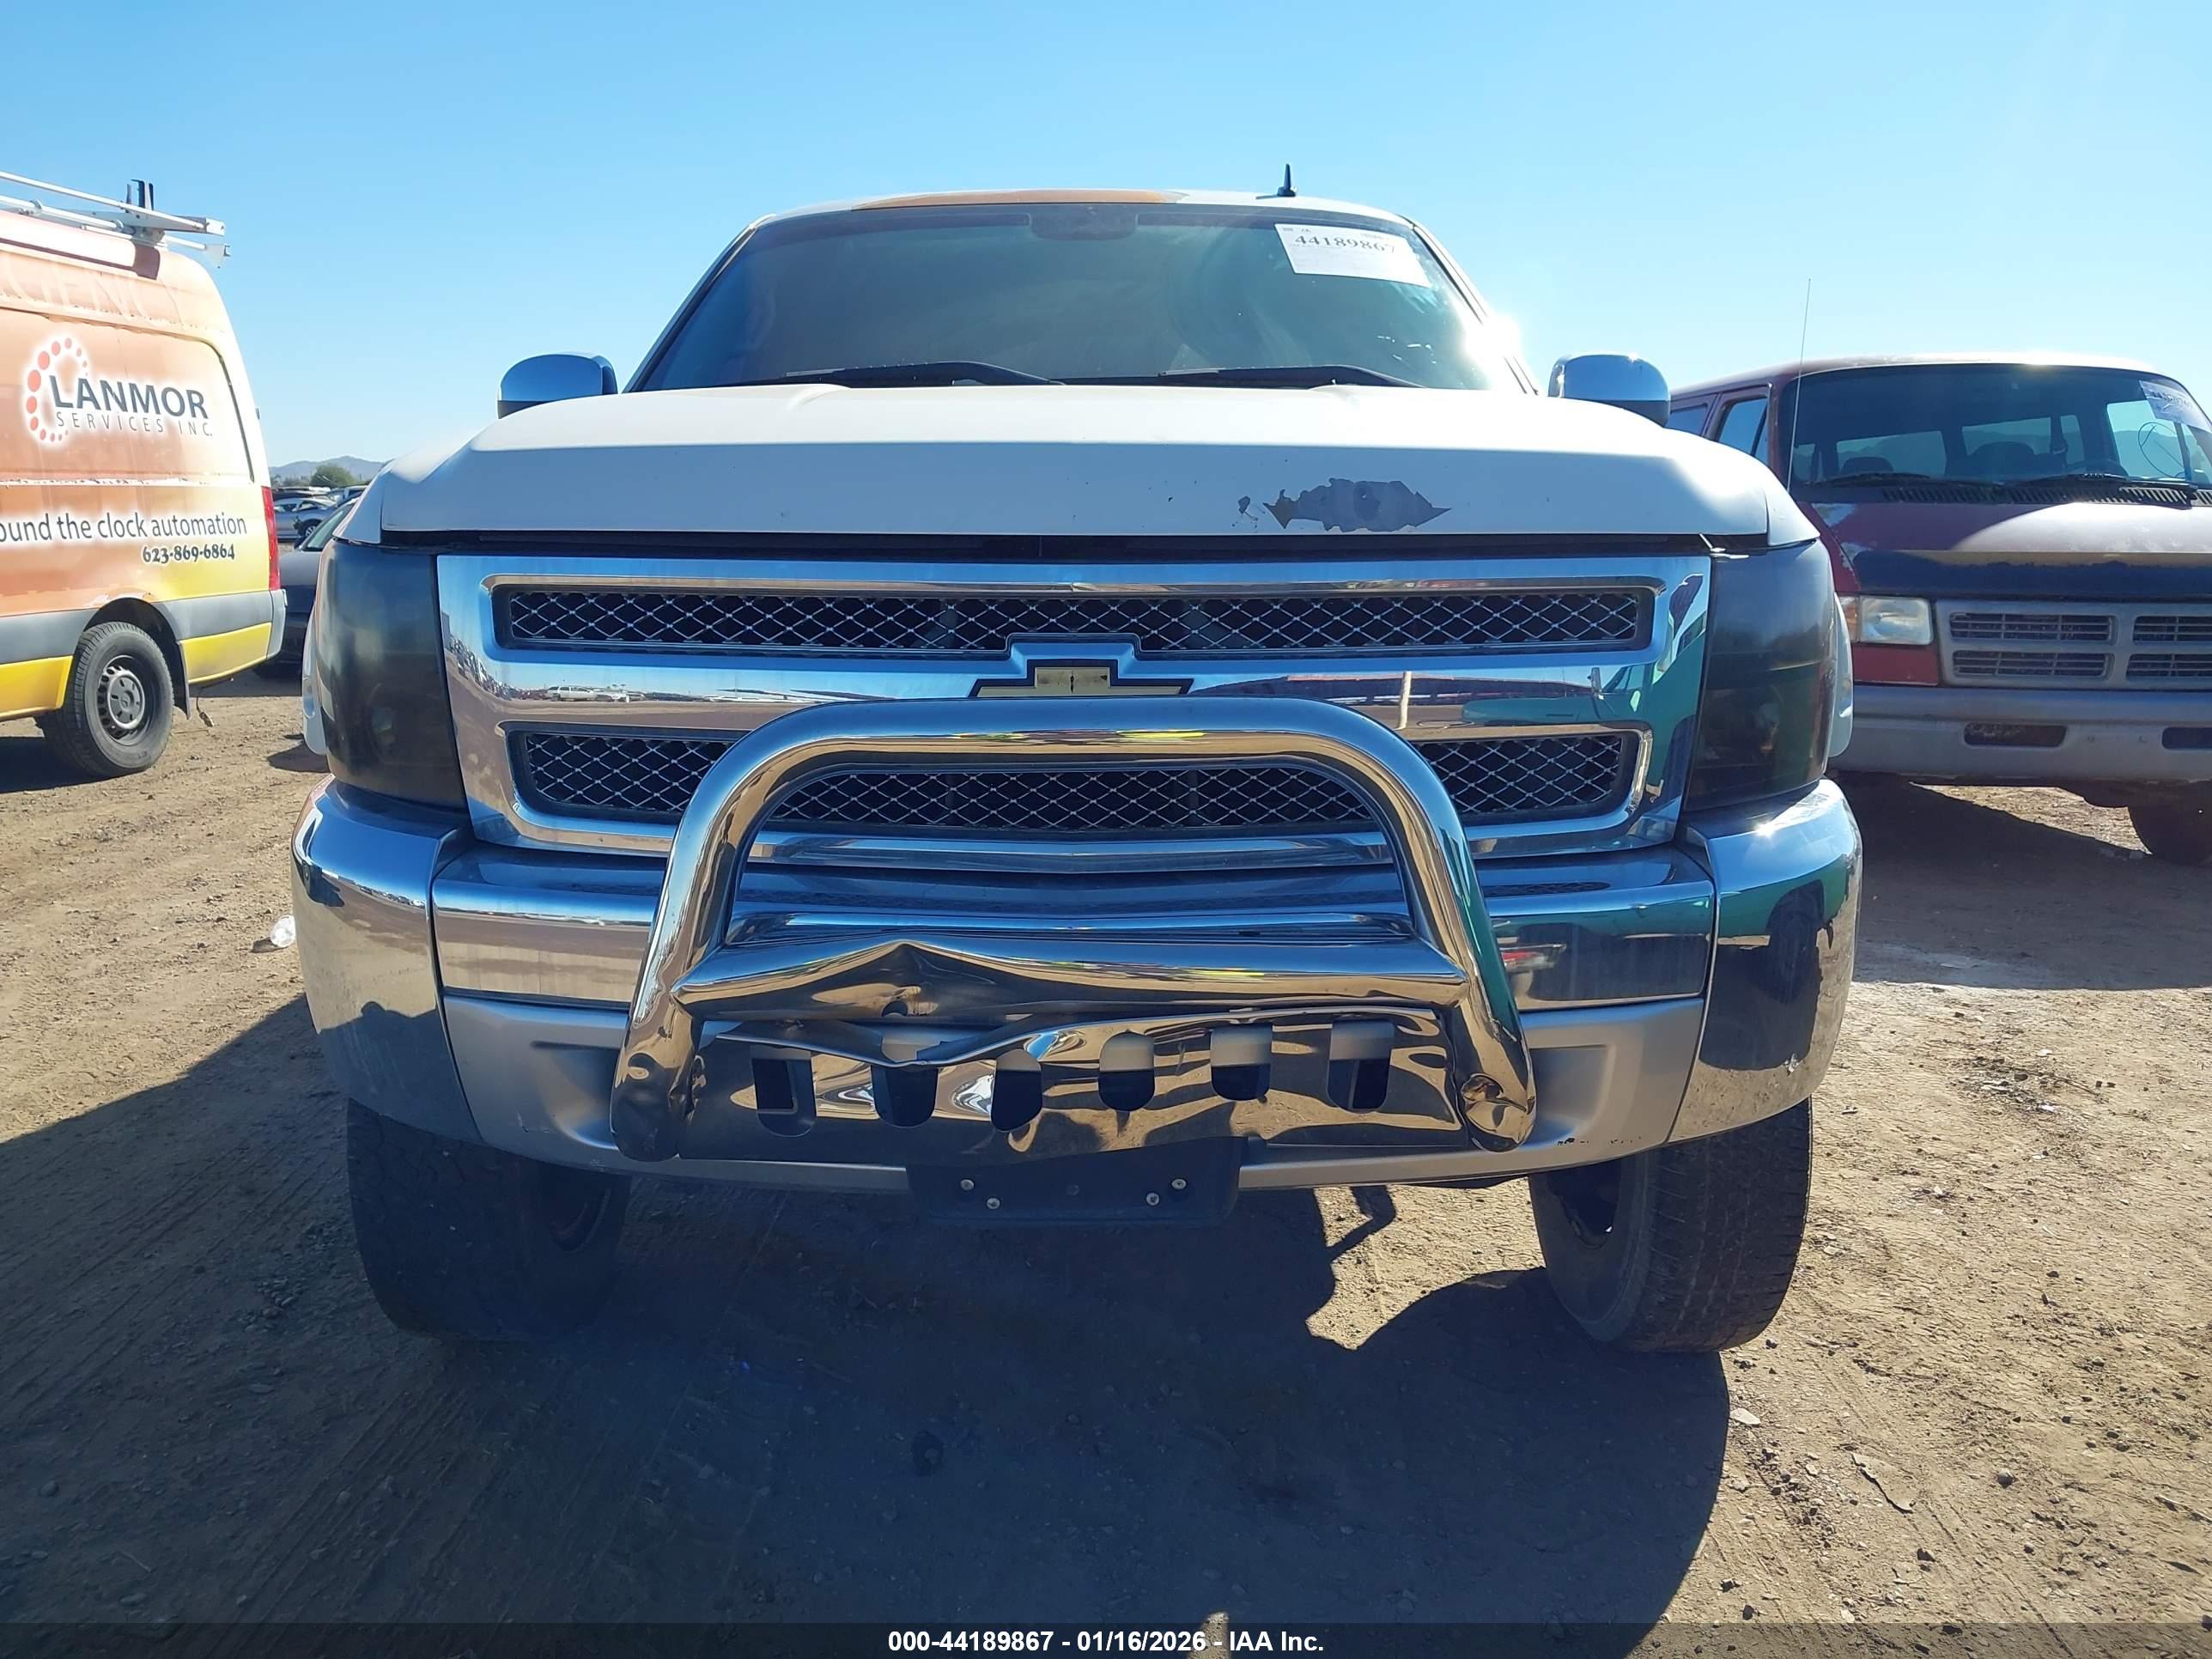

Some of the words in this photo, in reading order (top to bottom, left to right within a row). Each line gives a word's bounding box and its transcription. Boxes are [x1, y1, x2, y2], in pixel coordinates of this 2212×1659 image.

[1294, 234, 1395, 254] 44189867
[49, 375, 209, 419] LANMOR
[56, 411, 163, 432] SERVICES
[178, 420, 213, 436] INC.
[57, 513, 92, 539] the
[96, 512, 148, 538] clock
[150, 512, 247, 538] automation
[143, 544, 235, 564] 623-869-6864
